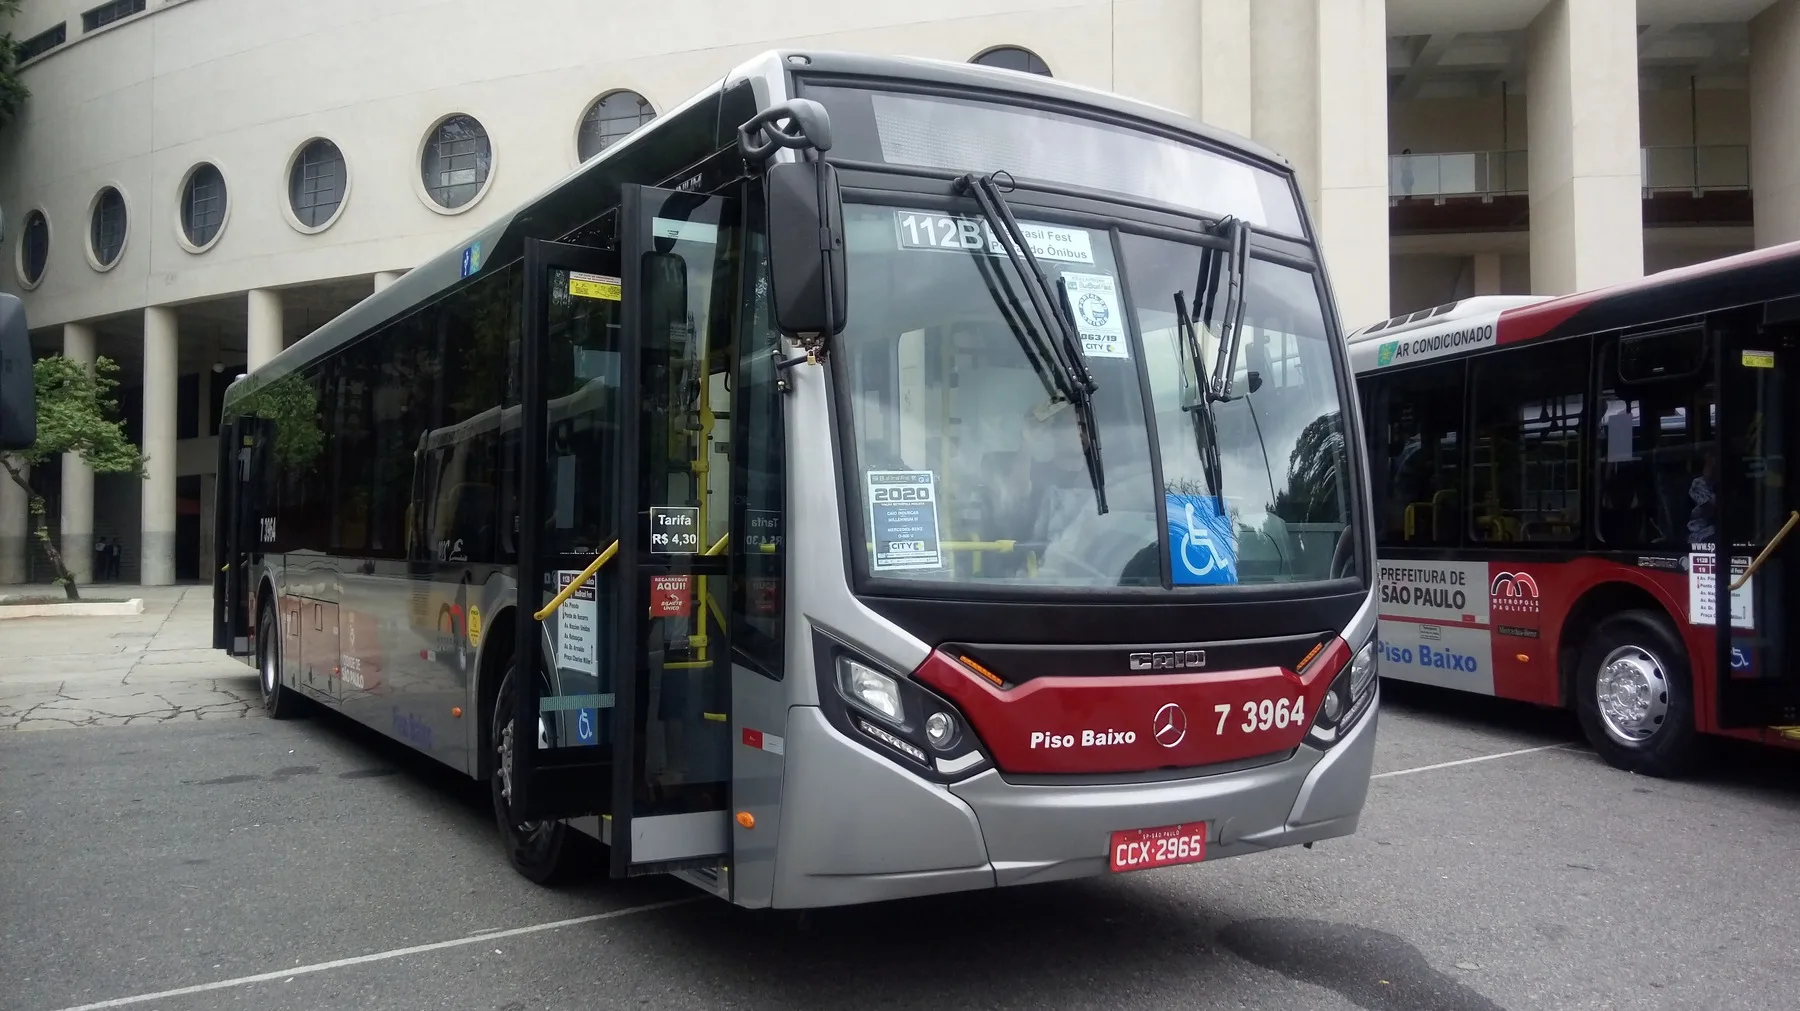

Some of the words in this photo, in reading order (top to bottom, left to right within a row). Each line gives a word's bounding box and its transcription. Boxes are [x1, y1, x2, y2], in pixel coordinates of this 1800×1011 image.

[902, 215, 984, 249] 112B
[1048, 231, 1072, 243] Fest
[1031, 245, 1044, 255] do
[1047, 244, 1088, 259] Ônibus
[1395, 342, 1409, 359] AR
[1412, 325, 1493, 355] CONDICIONADO
[875, 487, 930, 501] 2020
[657, 514, 692, 526] Tarifa
[652, 533, 669, 545] R$
[671, 533, 697, 546] 4,30
[1381, 567, 1447, 585] PREFEITURA
[1450, 571, 1466, 586] DE
[656, 582, 686, 591] AQUI!
[1381, 581, 1411, 605] SÃO
[1413, 587, 1466, 610] PAULO
[1492, 598, 1539, 607] METRÓPOLE
[1492, 604, 1540, 613] PAULISTA
[1419, 644, 1478, 673] Baixo
[1214, 703, 1231, 735] 7
[1241, 695, 1305, 733] 3964
[1030, 731, 1075, 749] Piso
[1081, 728, 1137, 747] Baixo
